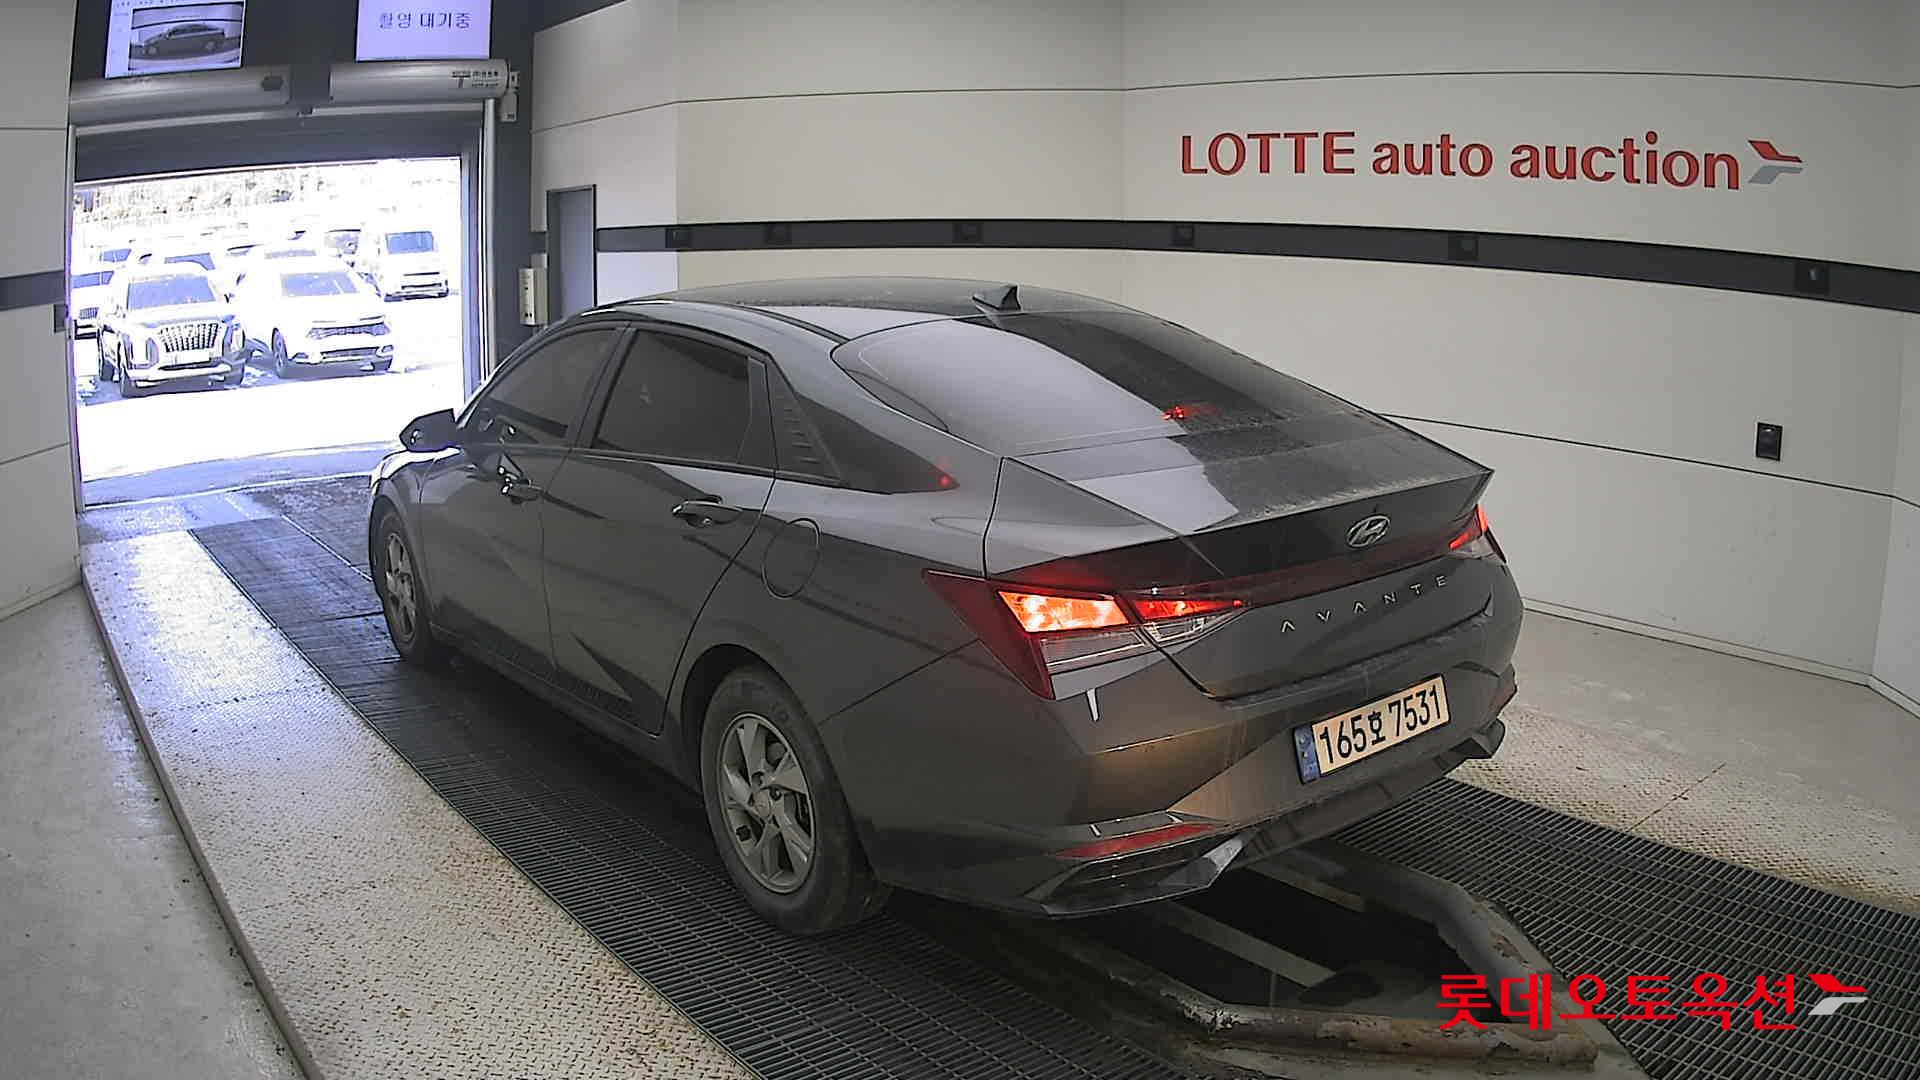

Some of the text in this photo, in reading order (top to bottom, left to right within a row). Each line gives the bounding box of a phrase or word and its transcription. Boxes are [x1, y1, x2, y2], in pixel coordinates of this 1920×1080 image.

[420, 12, 471, 29] 대기중
[1181, 130, 1741, 191] LOTTE auto auction
[1280, 575, 1448, 633] AVANTE
[1319, 710, 1386, 764] 165호
[1388, 684, 1441, 737] 7531
